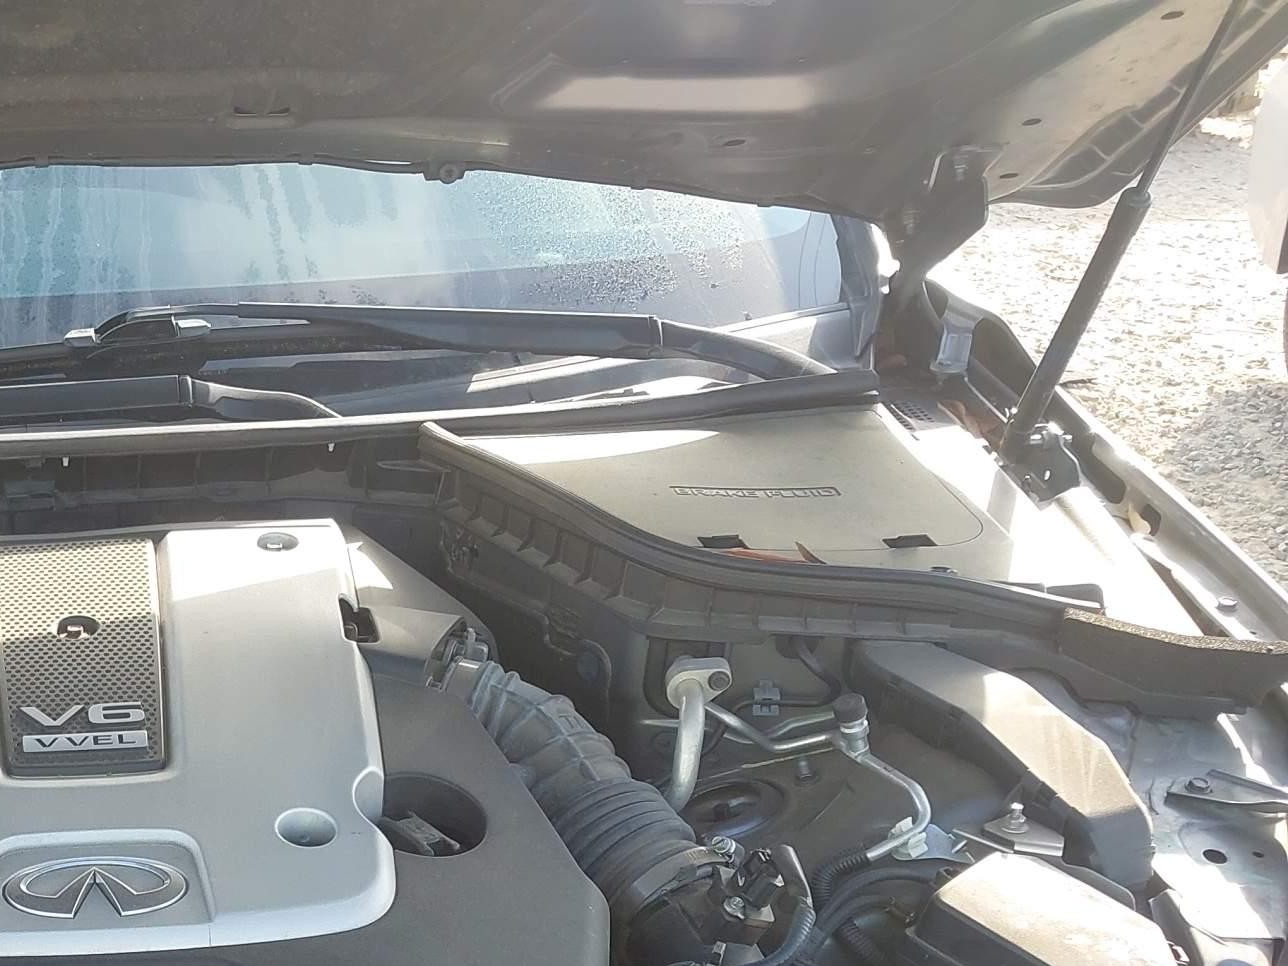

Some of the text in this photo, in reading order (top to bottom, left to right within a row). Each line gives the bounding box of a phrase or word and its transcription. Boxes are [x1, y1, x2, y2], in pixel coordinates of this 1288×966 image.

[673, 488, 836, 498] BRAKE FLUID
[20, 702, 145, 727] V6
[35, 734, 137, 748] VVEL
